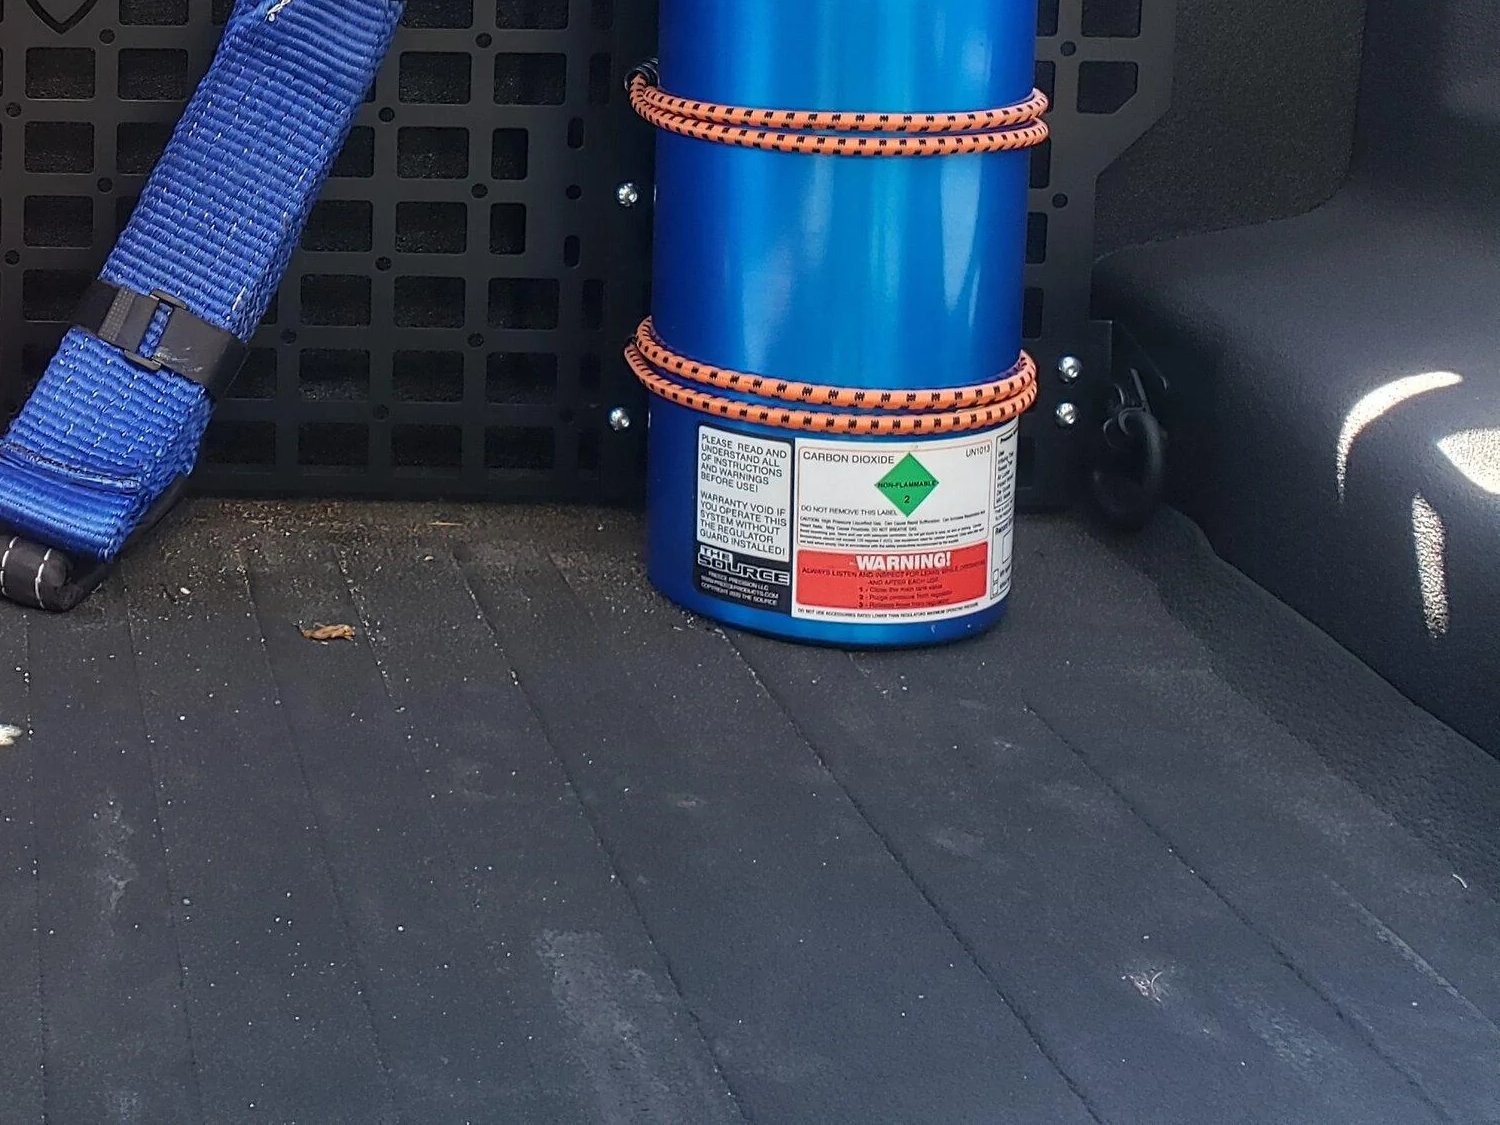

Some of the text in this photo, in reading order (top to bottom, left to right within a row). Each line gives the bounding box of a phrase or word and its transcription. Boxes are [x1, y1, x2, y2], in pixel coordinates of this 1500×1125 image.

[701, 433, 787, 459] PLEASE READ AND
[701, 443, 780, 468] UNDERSTAND ALL
[803, 451, 895, 464] CARBON DIOXIDE
[965, 444, 991, 457] UN1013
[701, 452, 783, 478] OF INSTRUCTIONS
[701, 462, 769, 485] AND WARNINGS
[701, 471, 758, 493] BEFORE USE!
[878, 480, 936, 488] NON-FLAMMABLE
[700, 490, 786, 517] WARRANTY VOID IF
[903, 495, 910, 503] 2
[700, 500, 787, 527] YOU OPERATE THIS
[700, 509, 734, 526] SYSTEM
[735, 519, 781, 535] WITHOUT
[829, 507, 859, 515] REMOVE
[700, 519, 774, 544] THE REGULATOR
[700, 528, 729, 544] GUARD
[731, 537, 786, 556] INSTALLED!
[700, 544, 733, 563] THE
[855, 551, 951, 571] WARNING!
[698, 552, 790, 586] SOURCE
[802, 567, 831, 575] ALWAYS
[832, 570, 857, 578] LISTEN
[700, 582, 728, 594] COPYRIGHT
[742, 593, 752, 602] THE
[752, 595, 778, 605] SOURCE
[728, 575, 757, 588] PRECISION
[758, 582, 769, 591] LLC
